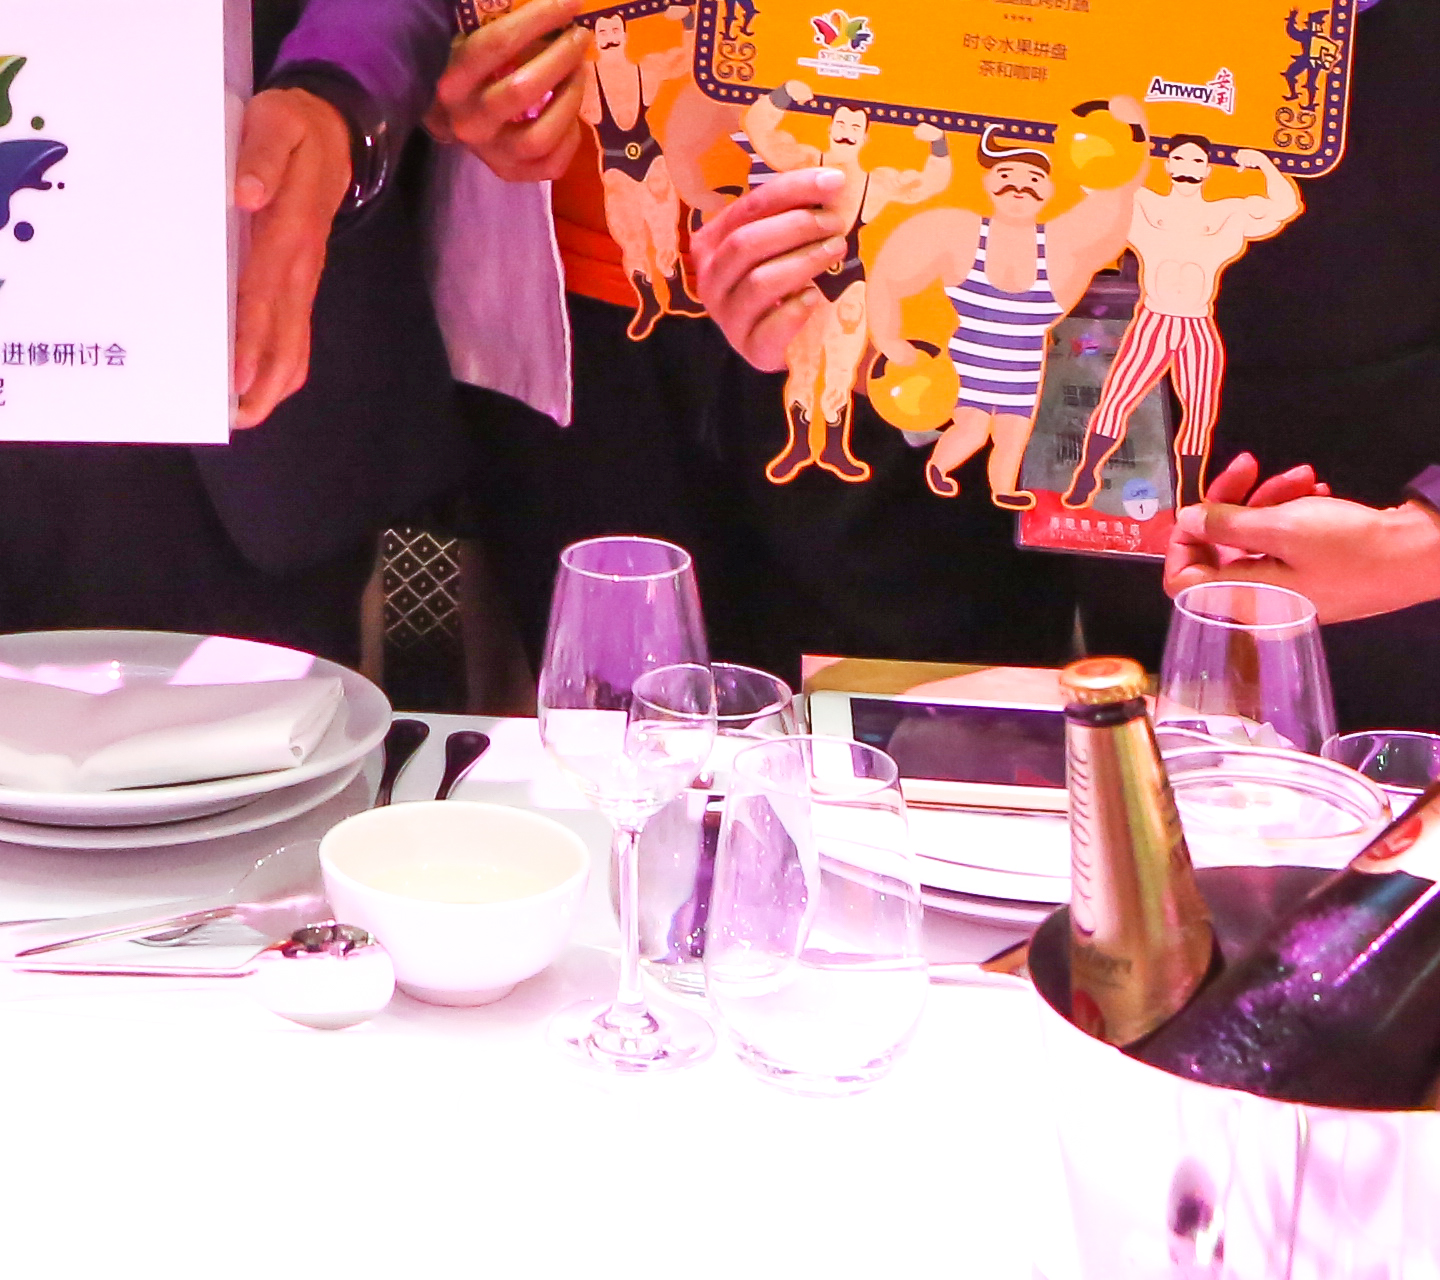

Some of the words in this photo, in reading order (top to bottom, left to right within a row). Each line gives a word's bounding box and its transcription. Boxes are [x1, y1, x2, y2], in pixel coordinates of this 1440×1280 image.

[961, 33, 1070, 62] 时令水果拼盘
[1149, 78, 1214, 104] Amway
